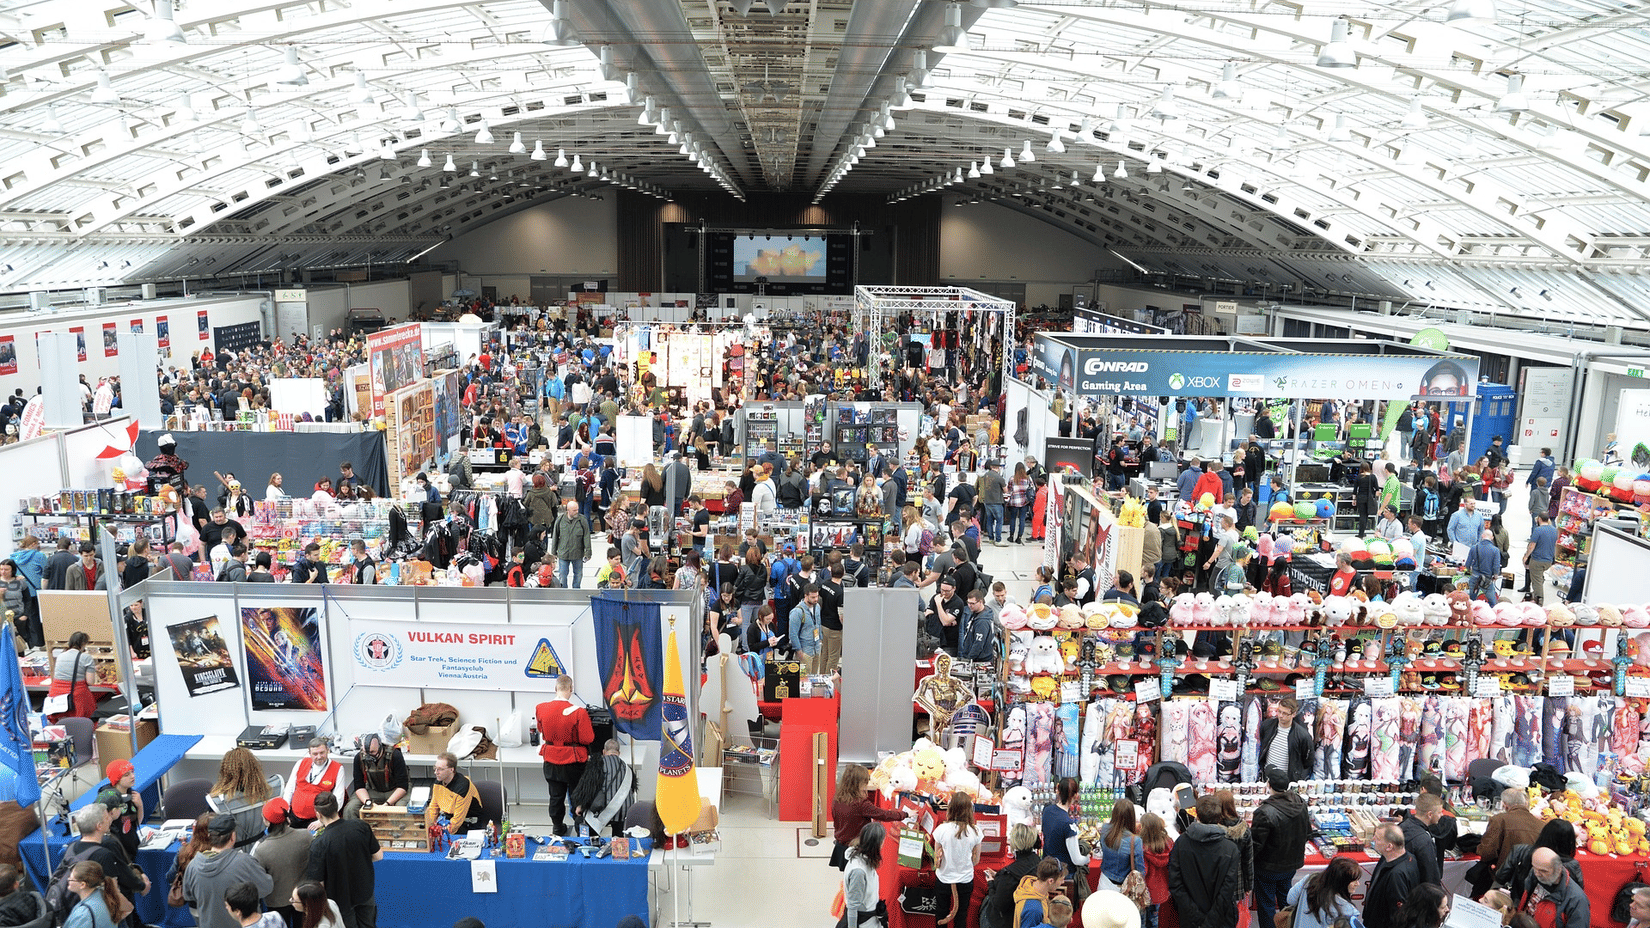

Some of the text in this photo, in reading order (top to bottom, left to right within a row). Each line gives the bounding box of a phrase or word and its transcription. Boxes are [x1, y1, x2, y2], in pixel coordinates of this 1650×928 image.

[1084, 357, 1149, 375] CONRAD
[1082, 380, 1147, 393] Gaming Area
[1187, 376, 1221, 388] XBOX
[1291, 379, 1337, 389] RAZER
[1345, 379, 1391, 390] OMEN
[407, 631, 516, 646] VULKAN SPIRIT
[410, 655, 426, 663] Star
[448, 656, 477, 664] Science
[442, 664, 484, 672] Fantasyclub
[659, 764, 691, 777] PLANETS
